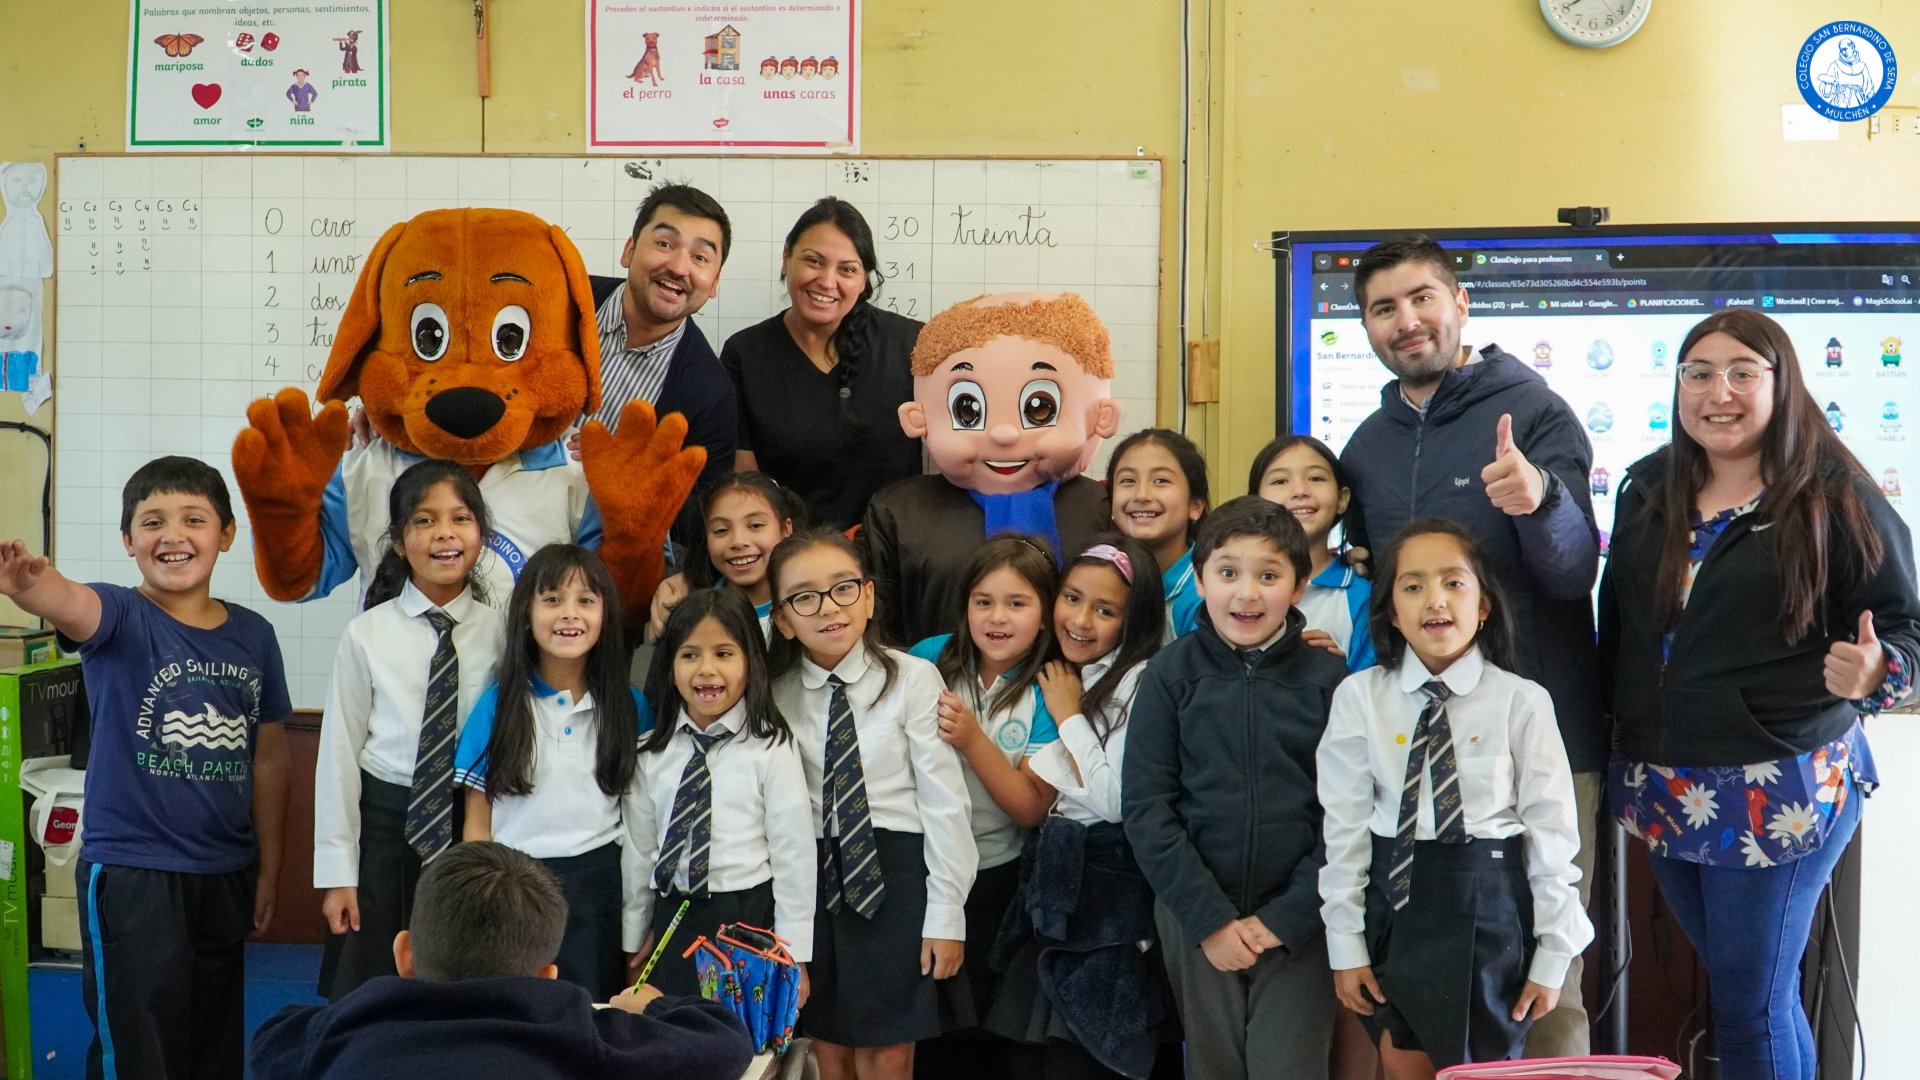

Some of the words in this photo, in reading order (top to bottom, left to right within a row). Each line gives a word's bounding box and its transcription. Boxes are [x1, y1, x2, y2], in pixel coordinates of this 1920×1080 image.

[144, 8, 179, 17] Palabras
[182, 9, 196, 17] que
[199, 7, 236, 15] nombran
[239, 6, 270, 16] objetos,
[273, 6, 312, 15] personas,
[315, 5, 371, 14] sentimientos,
[723, 4, 729, 12] si
[731, 4, 738, 12] el
[740, 4, 776, 12] sustantivo
[1617, 5, 1626, 15] 4
[234, 18, 260, 27] ideas,
[1575, 13, 1583, 26] 7
[1588, 18, 1598, 30] 6
[1605, 14, 1614, 26] 5
[154, 61, 204, 73] mariposa
[240, 56, 274, 67] dados
[332, 77, 367, 89] pirata
[699, 73, 712, 85] la
[716, 75, 746, 85] casa
[623, 87, 634, 99] el
[639, 88, 672, 102] perro
[764, 89, 796, 99] unas
[800, 89, 836, 99] caras
[193, 116, 222, 126] amor
[290, 115, 315, 126] niña
[310, 218, 356, 237] cero
[884, 216, 919, 240] 30
[950, 204, 1058, 248] treinta
[266, 250, 277, 273] 1
[310, 254, 362, 274] uno
[1490, 255, 1522, 265] ClassDojo
[1523, 256, 1538, 264] para
[1538, 255, 1573, 264] profesores
[885, 262, 915, 280] 31
[264, 285, 279, 308] 2
[310, 282, 346, 311] dos
[1776, 297, 1806, 305] Wordwall
[1811, 297, 1826, 306] Cree
[1561, 300, 1583, 308] unidad
[266, 322, 279, 344] 3
[1317, 352, 1334, 360] San
[264, 355, 280, 376] 4
[136, 662, 182, 740] ADVANCED
[137, 752, 193, 774] BEACH
[149, 768, 181, 778] NORTH
